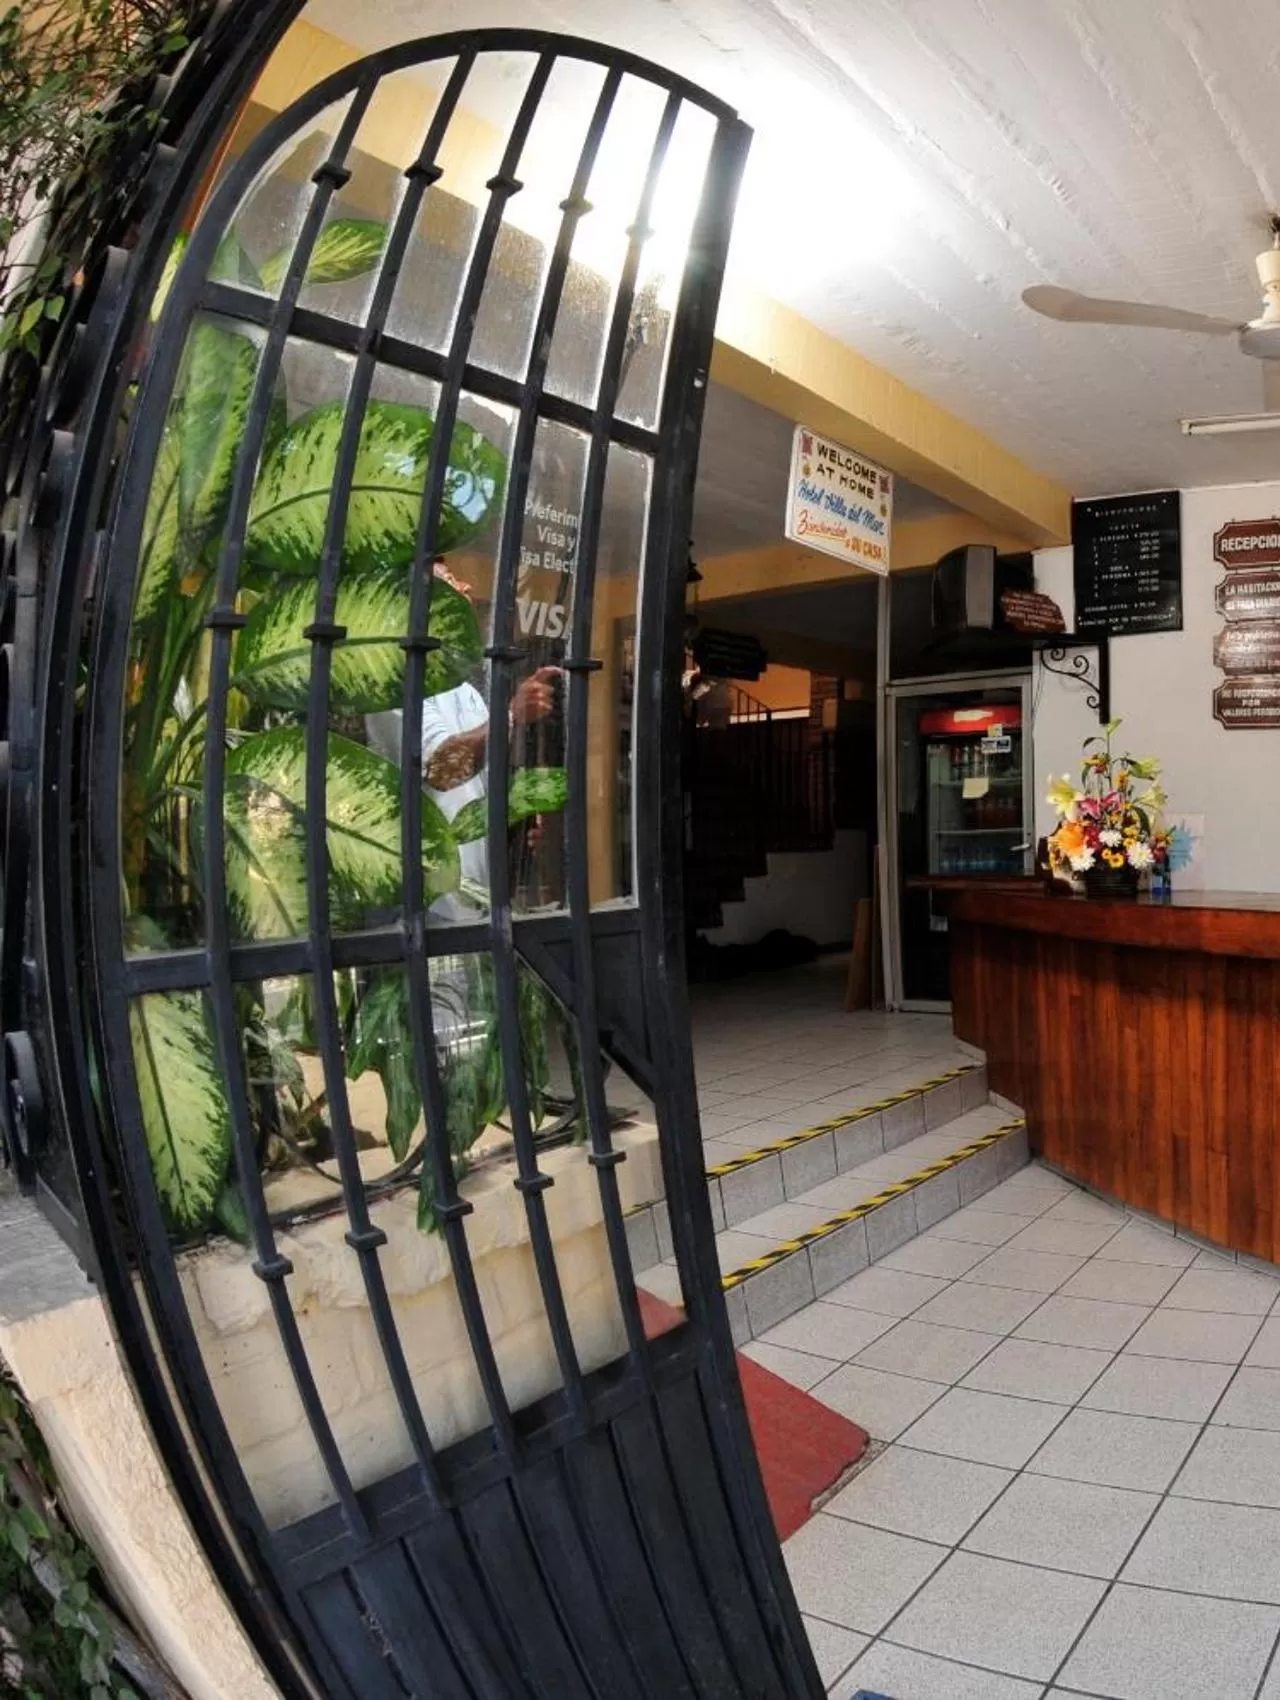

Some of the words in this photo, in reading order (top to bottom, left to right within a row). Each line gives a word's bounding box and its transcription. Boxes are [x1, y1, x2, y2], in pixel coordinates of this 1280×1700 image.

[817, 442, 877, 484] WELCOME
[817, 463, 835, 480] AT
[840, 475, 874, 500] HOME
[525, 499, 577, 529] Preferim
[537, 524, 566, 547] Visa
[567, 536, 575, 552] y
[521, 547, 540, 567] isa
